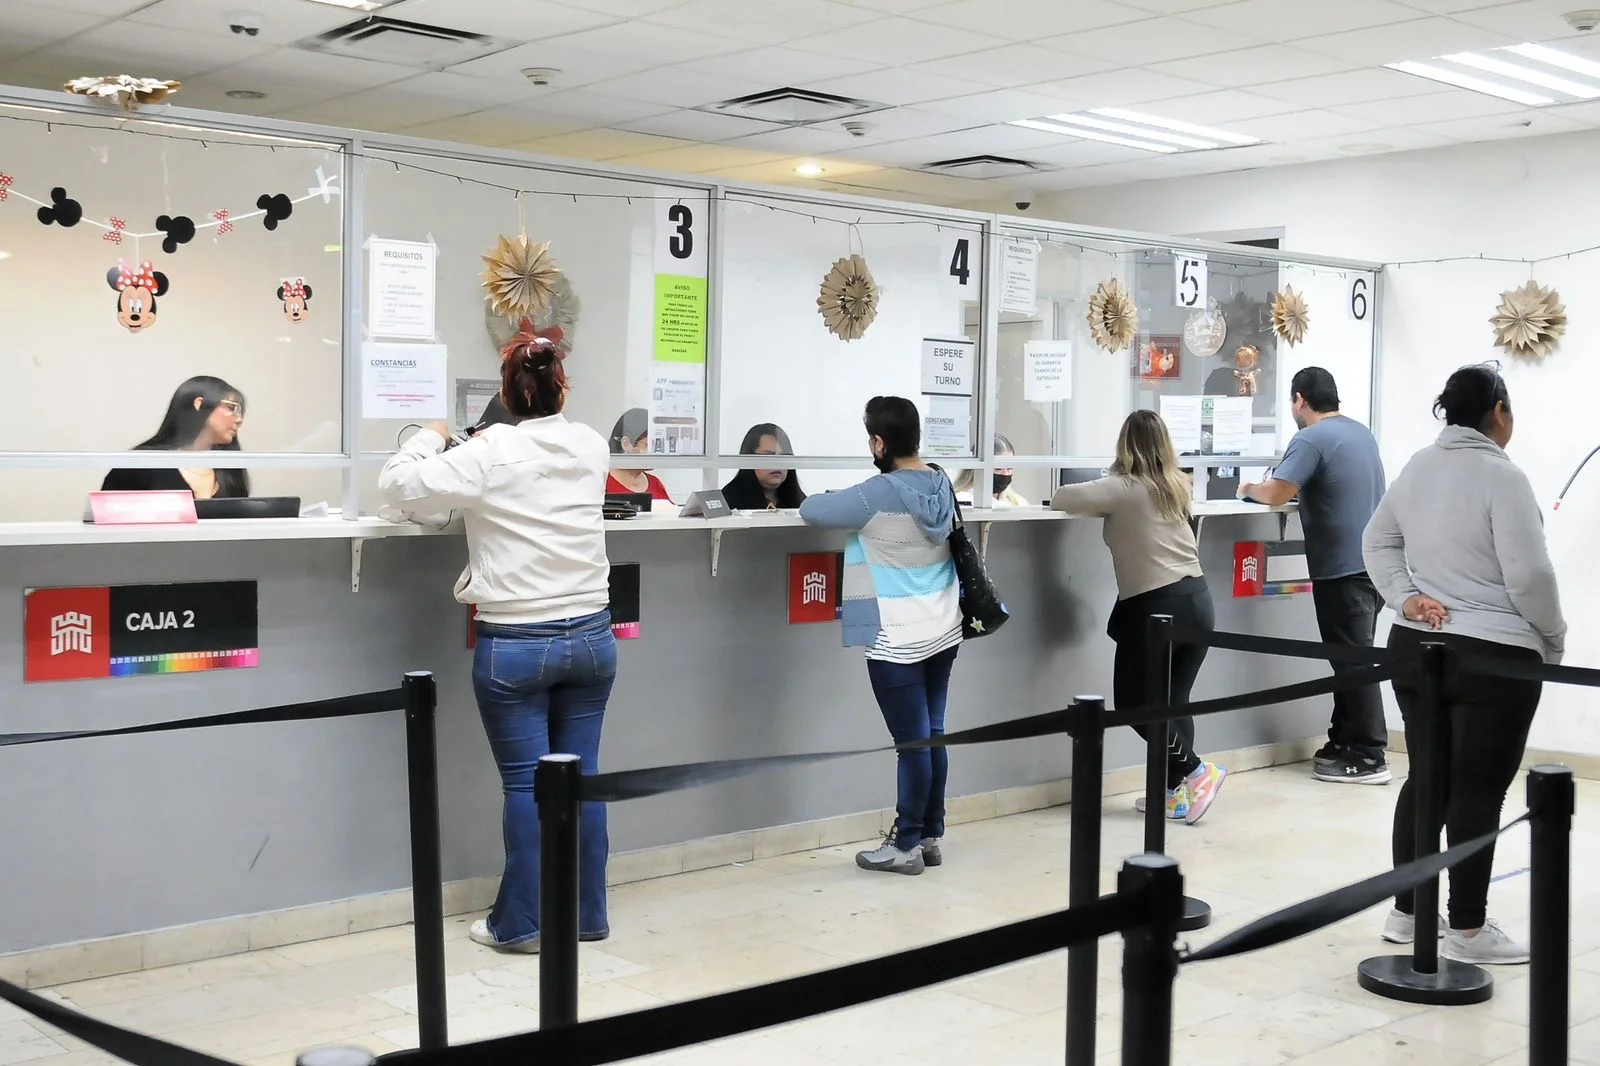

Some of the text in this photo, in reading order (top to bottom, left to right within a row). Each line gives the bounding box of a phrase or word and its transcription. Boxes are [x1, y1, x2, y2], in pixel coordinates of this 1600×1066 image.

[668, 204, 693, 260] 3
[384, 250, 423, 261] REQUISITOS
[950, 238, 970, 286] 4
[1180, 259, 1199, 307] 5
[664, 293, 698, 301] IMPORTANTE
[1352, 278, 1367, 321] 6
[933, 347, 964, 359] ESPERE
[370, 359, 417, 369] CONSTANCIAS
[943, 362, 954, 372] SU
[935, 375, 961, 386] TURNO
[126, 610, 195, 632] CAJA 2
